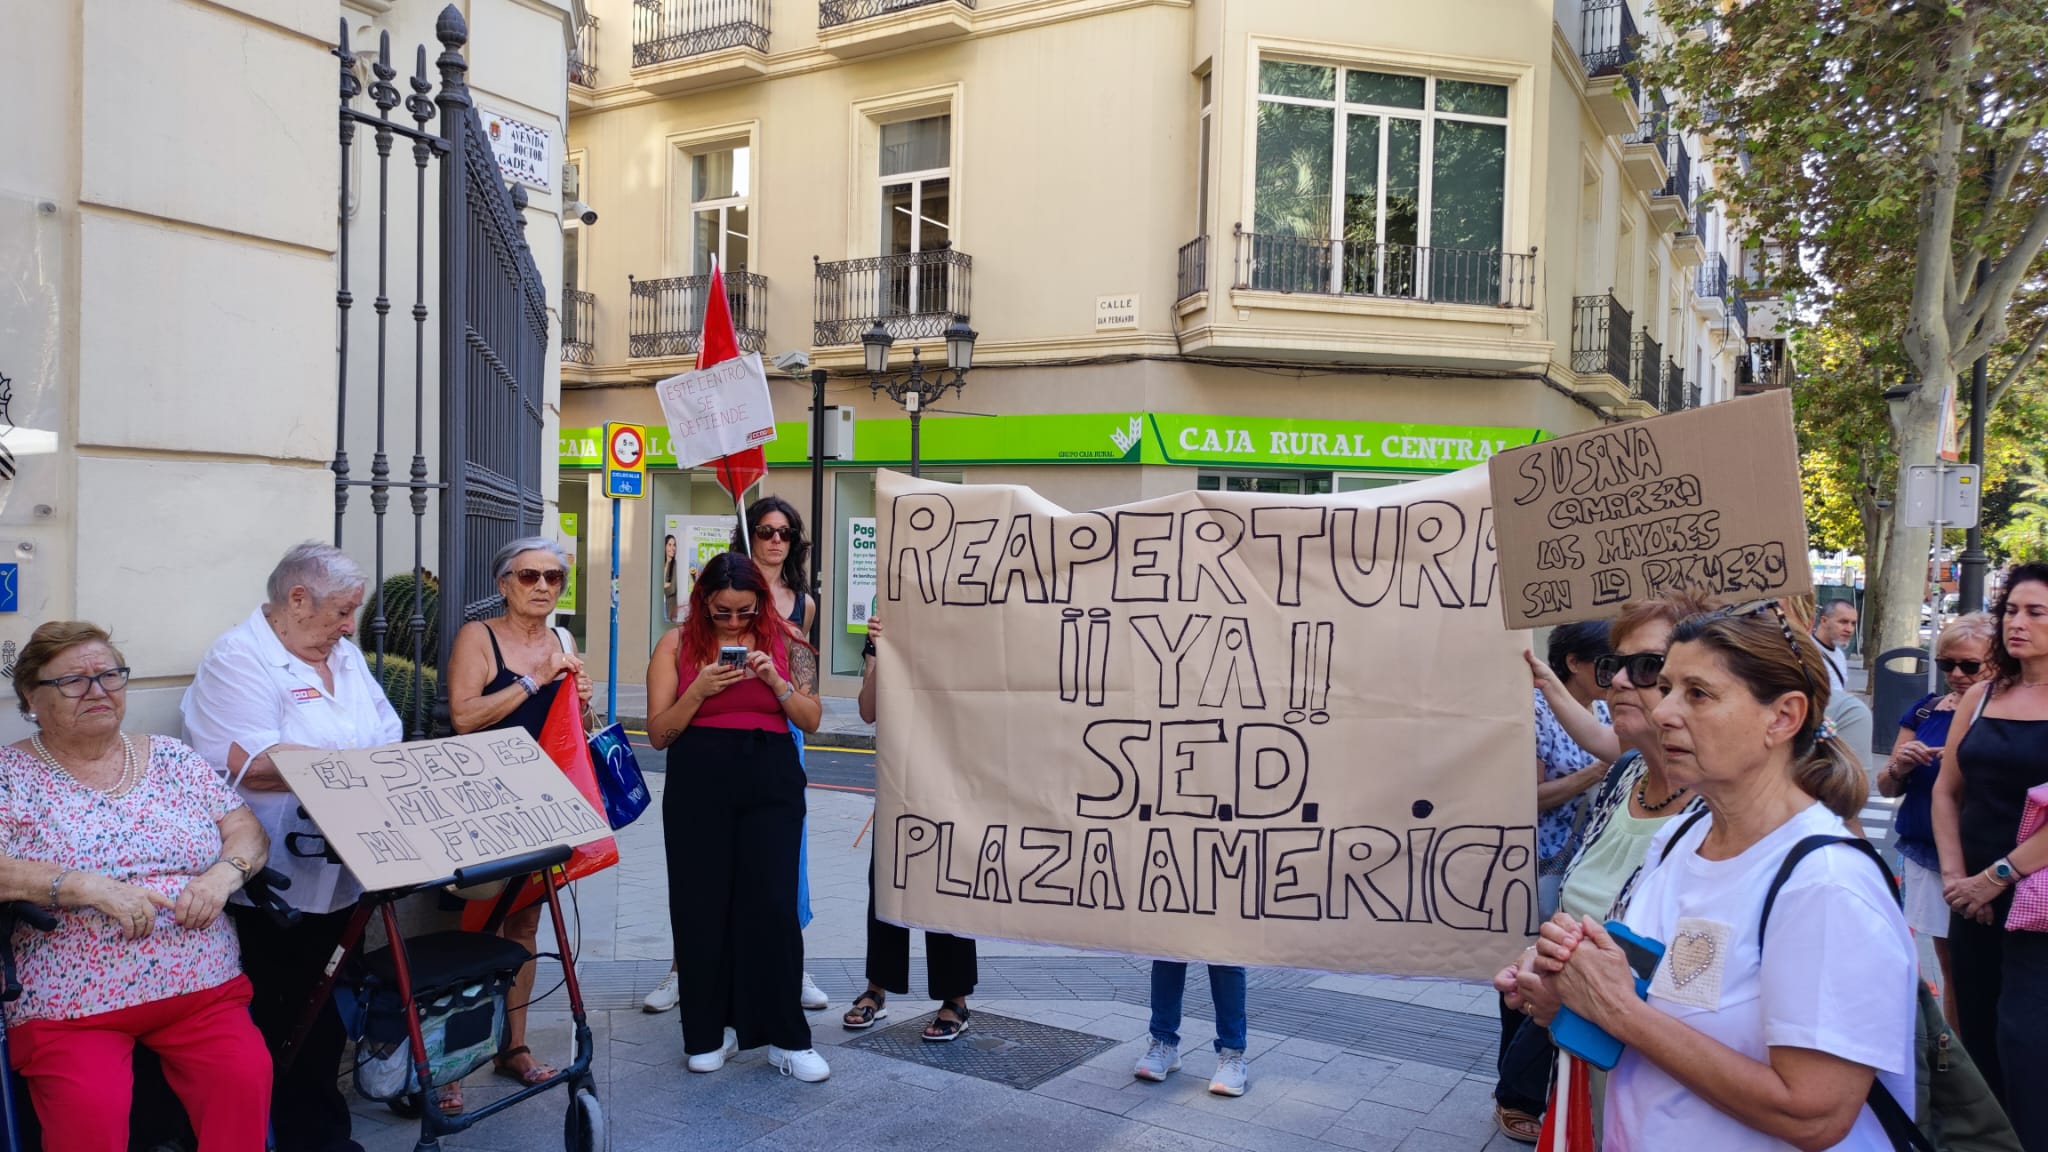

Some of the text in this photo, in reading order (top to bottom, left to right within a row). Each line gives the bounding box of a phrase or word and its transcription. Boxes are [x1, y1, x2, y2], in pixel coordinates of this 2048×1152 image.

[511, 130, 544, 149] AVENIDA
[513, 143, 543, 161] DOCTOR
[1099, 299, 1132, 310] CALLE
[665, 363, 747, 401] ESTE CENTRO
[679, 404, 751, 438] DEFIENDE
[697, 396, 715, 414] SE
[1178, 427, 1256, 453] CAJA
[1269, 431, 1372, 458] RURAL
[1514, 427, 1662, 505] SUSANA
[1548, 473, 1702, 529] CAMARERO
[853, 523, 877, 538] Pag
[1537, 510, 1720, 570] LOS MAYORES
[1522, 580, 1572, 618] SON
[1591, 568, 1632, 606] LO
[370, 742, 486, 790] SED
[488, 737, 540, 766] ES
[1077, 719, 1319, 822] S.E.D.
[894, 815, 1125, 910] PLAZA
